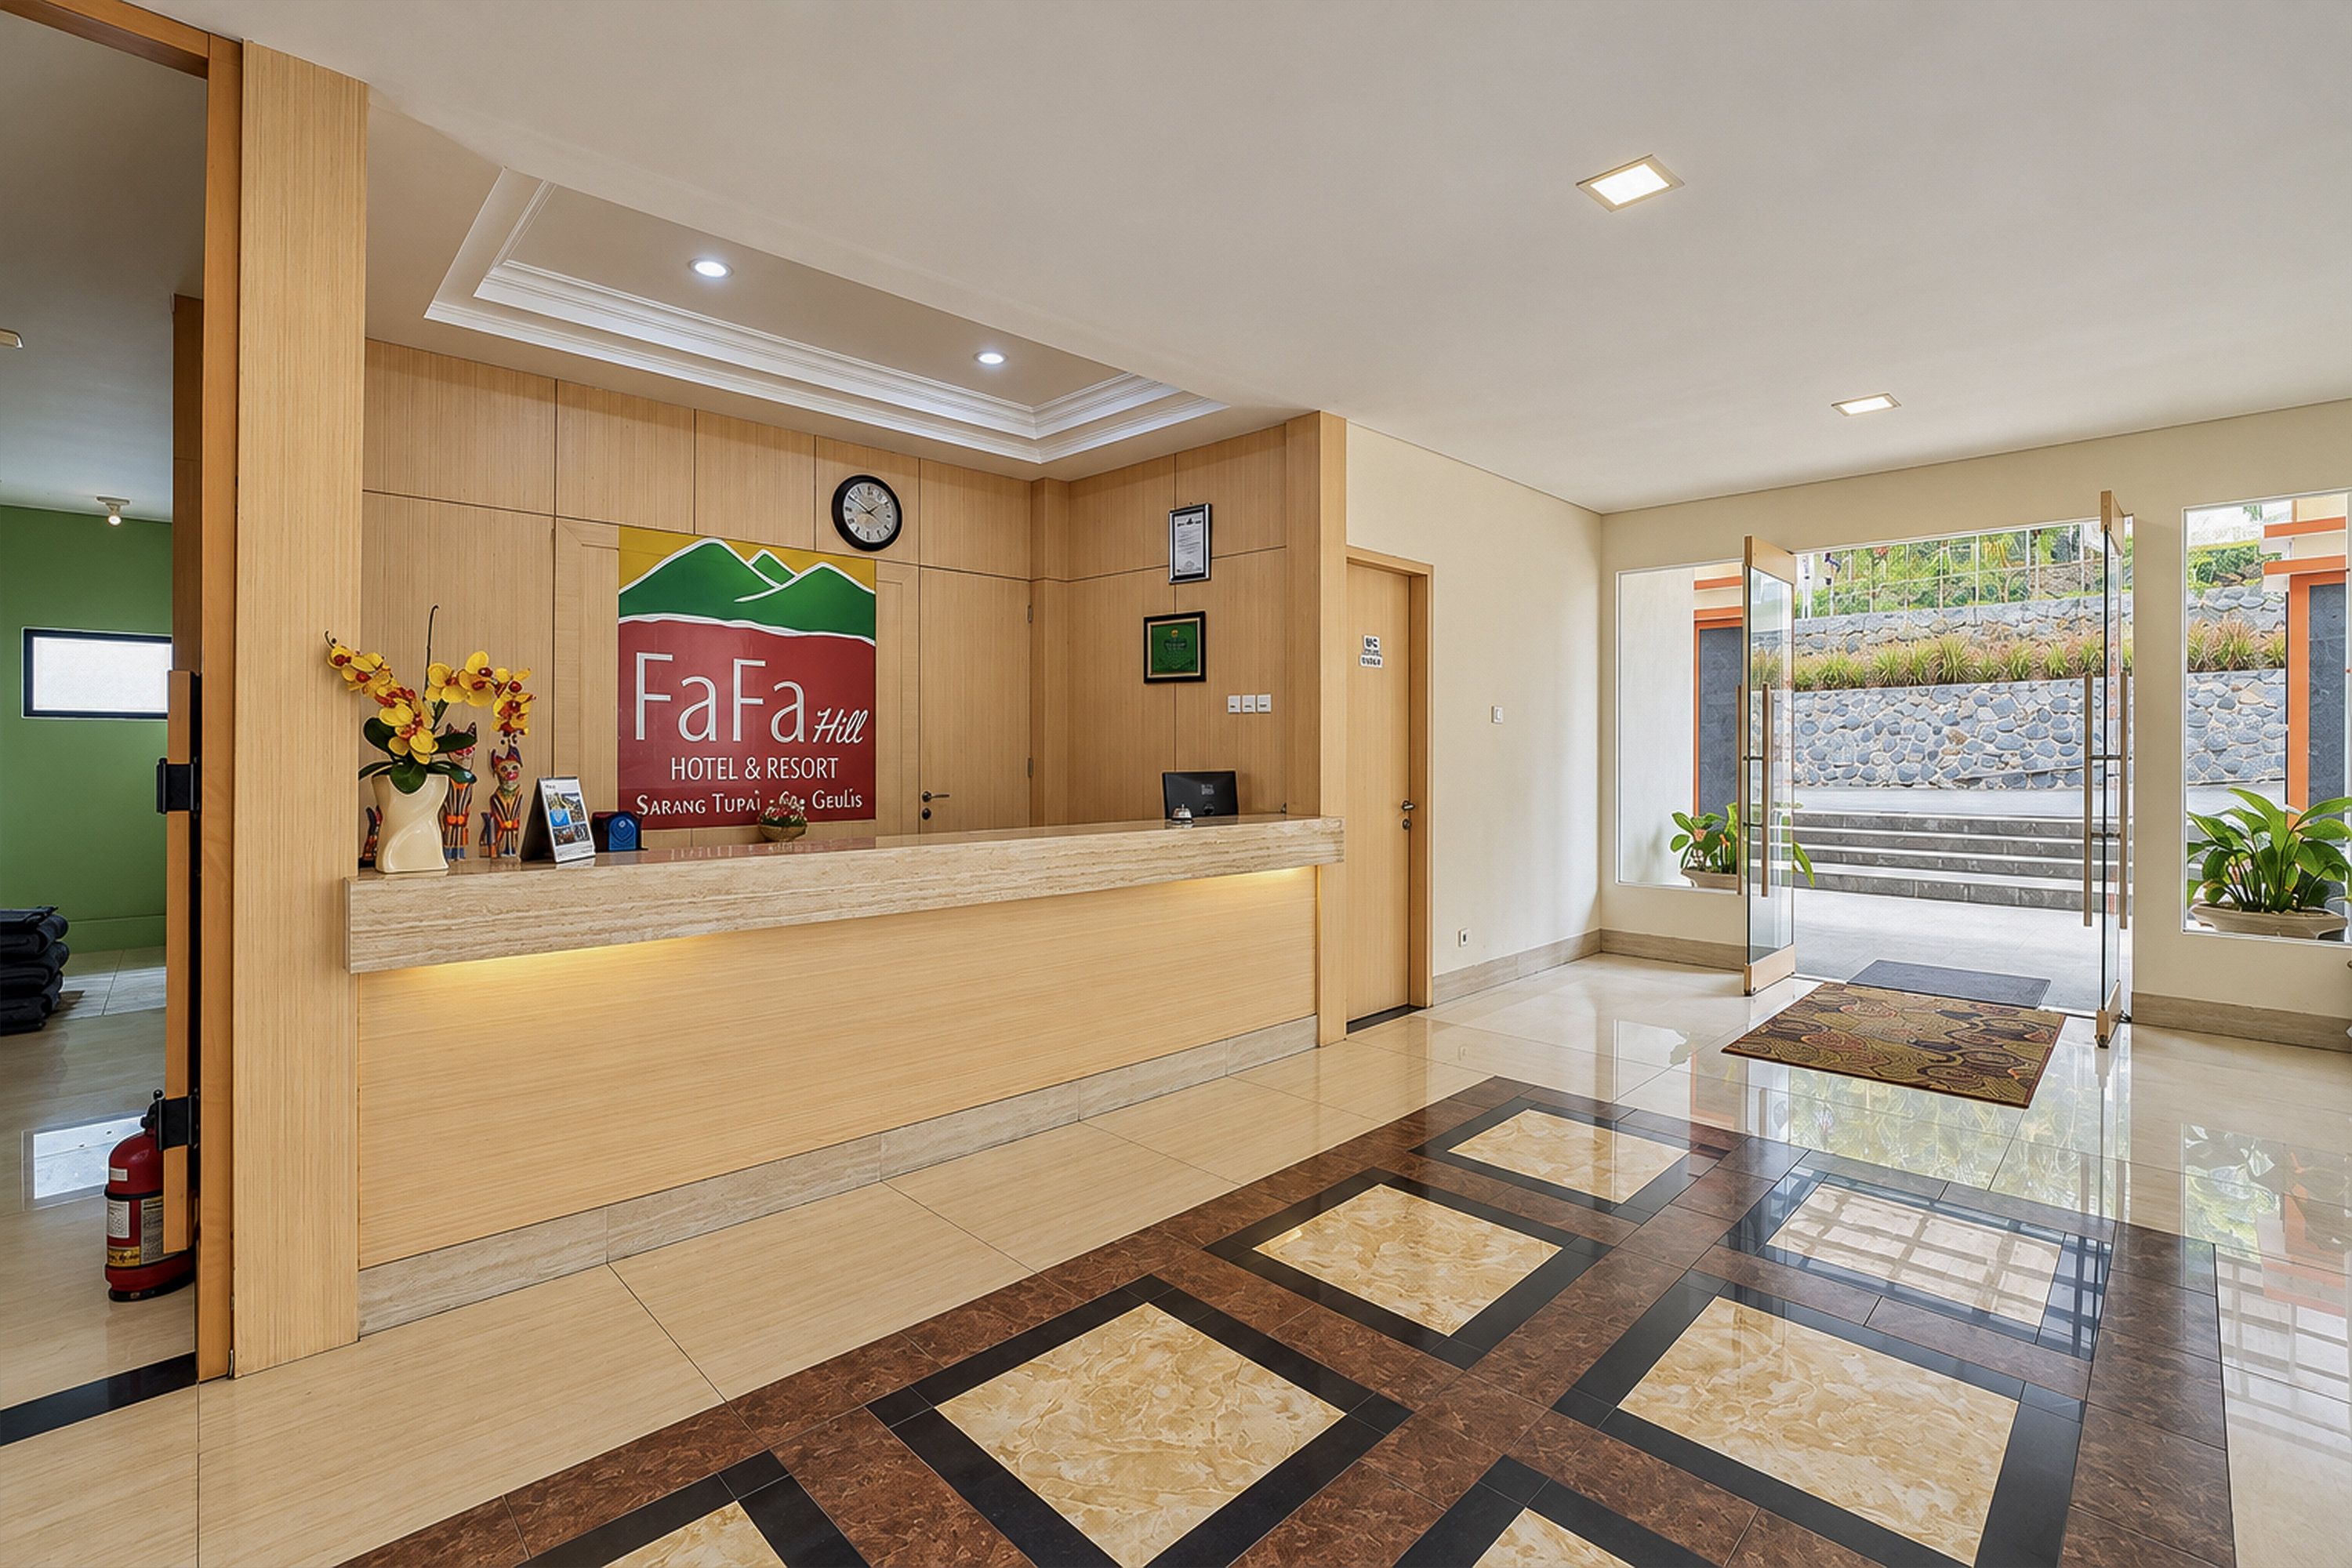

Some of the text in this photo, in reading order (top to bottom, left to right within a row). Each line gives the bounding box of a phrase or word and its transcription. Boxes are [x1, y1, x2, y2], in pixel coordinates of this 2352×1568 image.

[635, 652, 869, 744] FaFa Hill
[670, 757, 839, 781] HOTEL & RESORT
